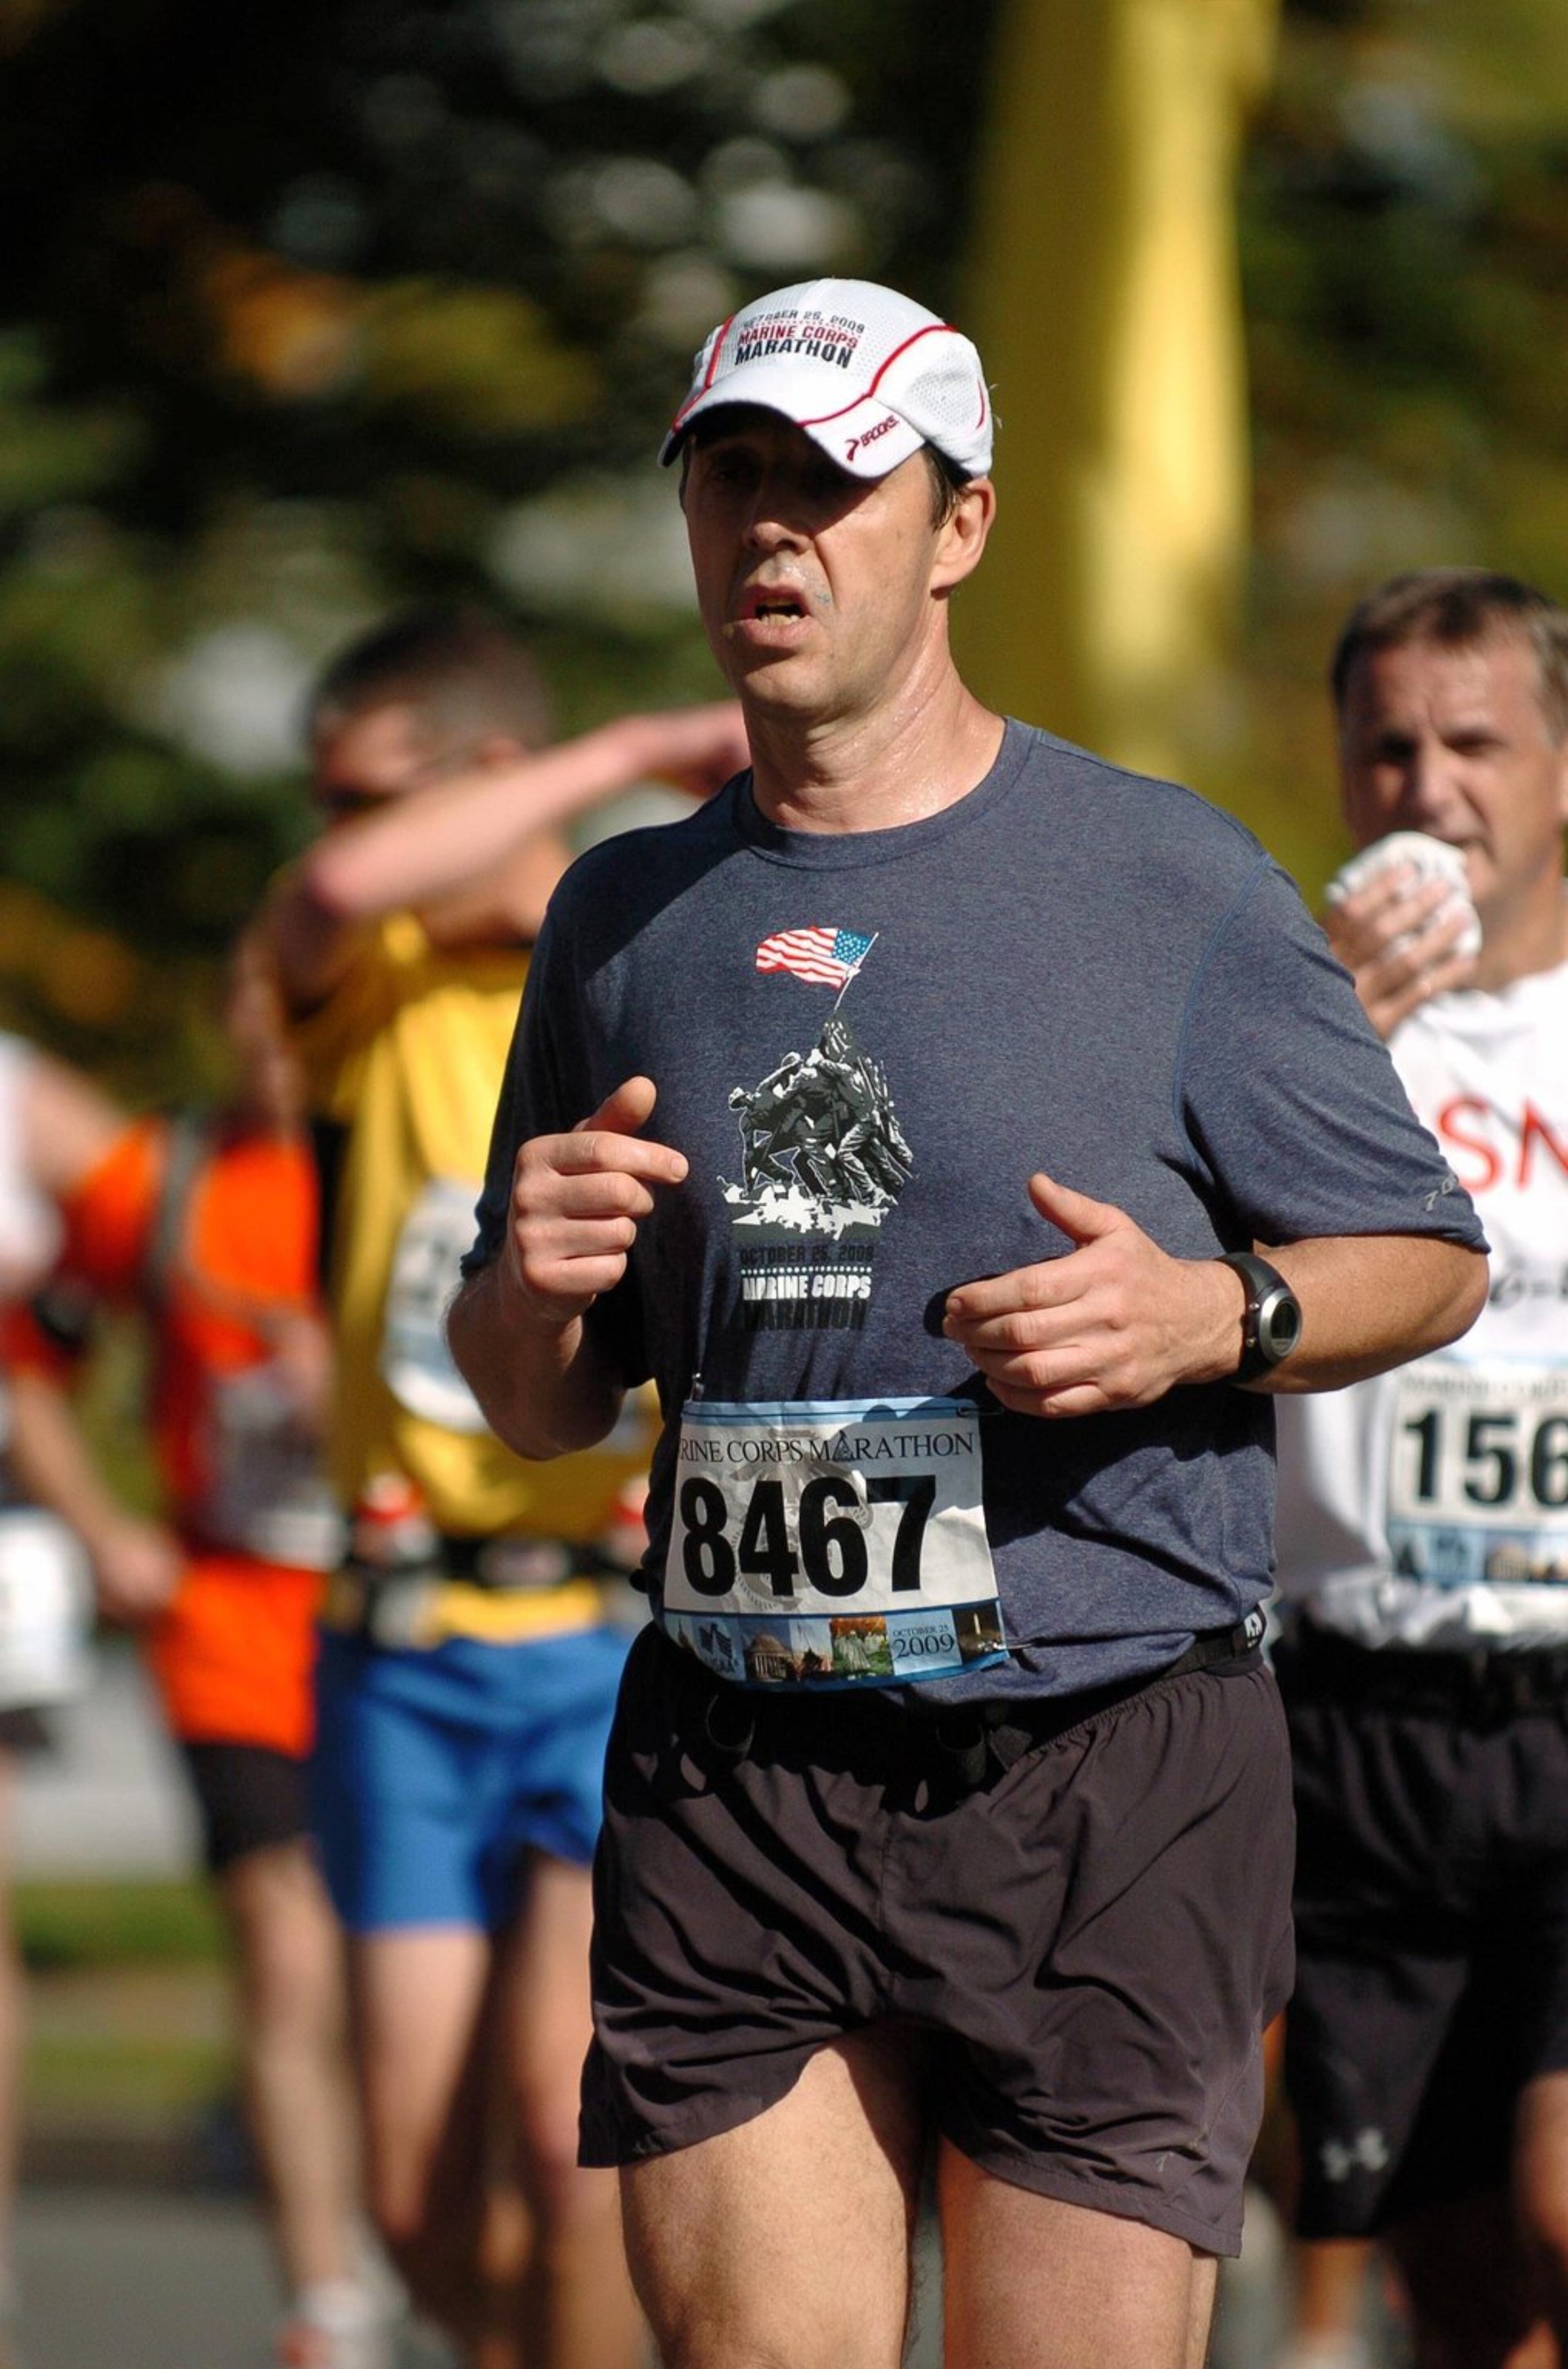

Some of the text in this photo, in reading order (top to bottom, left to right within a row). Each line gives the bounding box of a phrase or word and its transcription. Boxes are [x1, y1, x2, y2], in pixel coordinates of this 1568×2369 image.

[738, 325, 858, 349] MARINE CORPS
[829, 315, 865, 334] 2009
[735, 339, 853, 369] MARATHON
[740, 1245, 805, 1264] OCTOBER
[742, 1274, 872, 1300] MARINE CORPS
[680, 1430, 974, 1463] RINE CORPS MARATHON
[1405, 1408, 1568, 1507] 156
[680, 1474, 936, 1597] 8467
[893, 1626, 936, 1637] OCTOBER
[893, 1633, 955, 1658] 2009
